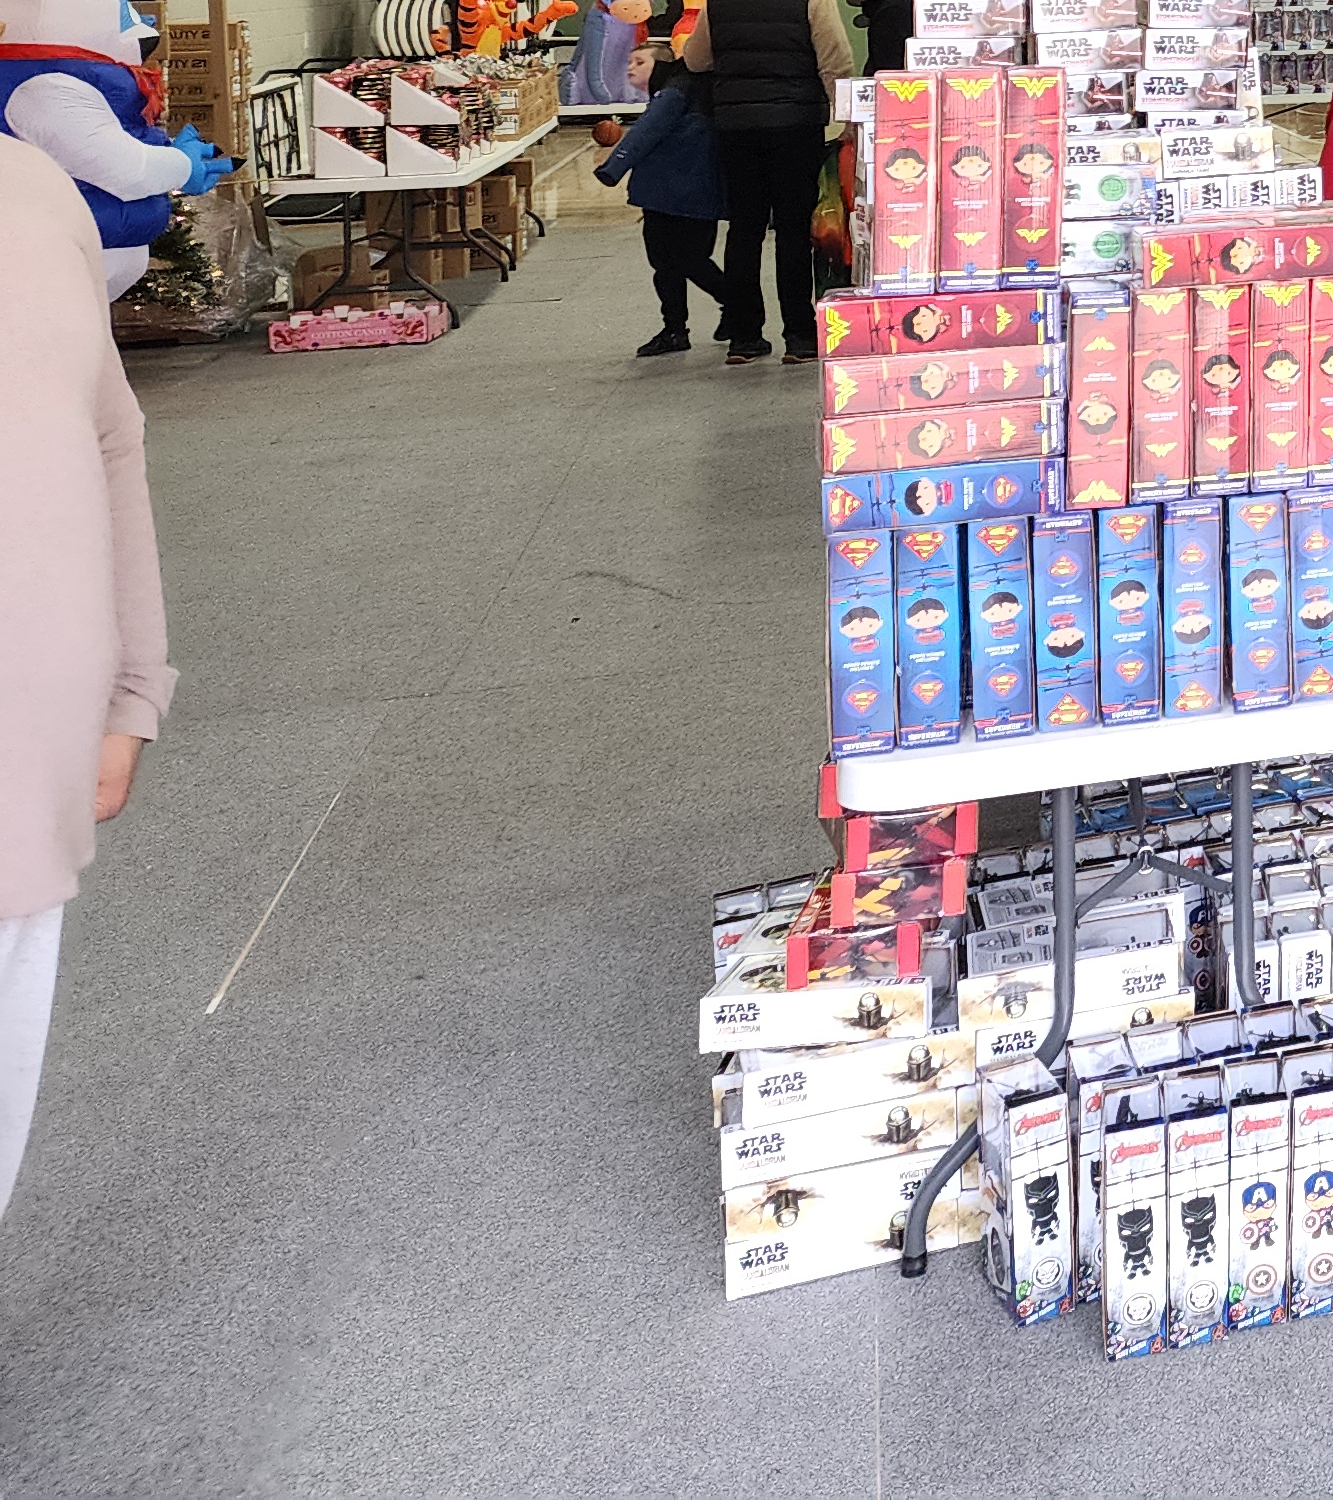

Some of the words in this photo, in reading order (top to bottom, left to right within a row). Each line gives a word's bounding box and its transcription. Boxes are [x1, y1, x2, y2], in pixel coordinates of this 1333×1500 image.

[924, 2, 972, 12] STAR
[1158, 3, 1203, 12] WARS
[924, 12, 973, 22] WARS
[1153, 36, 1200, 45] STAR
[913, 45, 962, 56] STAR
[1154, 45, 1200, 55] WARS
[913, 56, 961, 66] WARS
[1143, 76, 1188, 86] STAR
[1143, 86, 1188, 96] WARS
[1166, 137, 1213, 147] STAR
[1067, 145, 1099, 156] TAR
[1167, 147, 1213, 158] WARS
[1305, 950, 1315, 990] WARS
[1313, 949, 1323, 988] STAR
[713, 1002, 760, 1014] STAR
[713, 1013, 760, 1025] WARS
[991, 1029, 1036, 1045] STAR
[990, 1040, 1037, 1055] WARS
[758, 1071, 807, 1088] STAR
[758, 1081, 807, 1098] WARS
[735, 1132, 785, 1149] STAR
[736, 1142, 785, 1160] WARS
[739, 1241, 789, 1260] STAR
[740, 1251, 789, 1269] WARS
